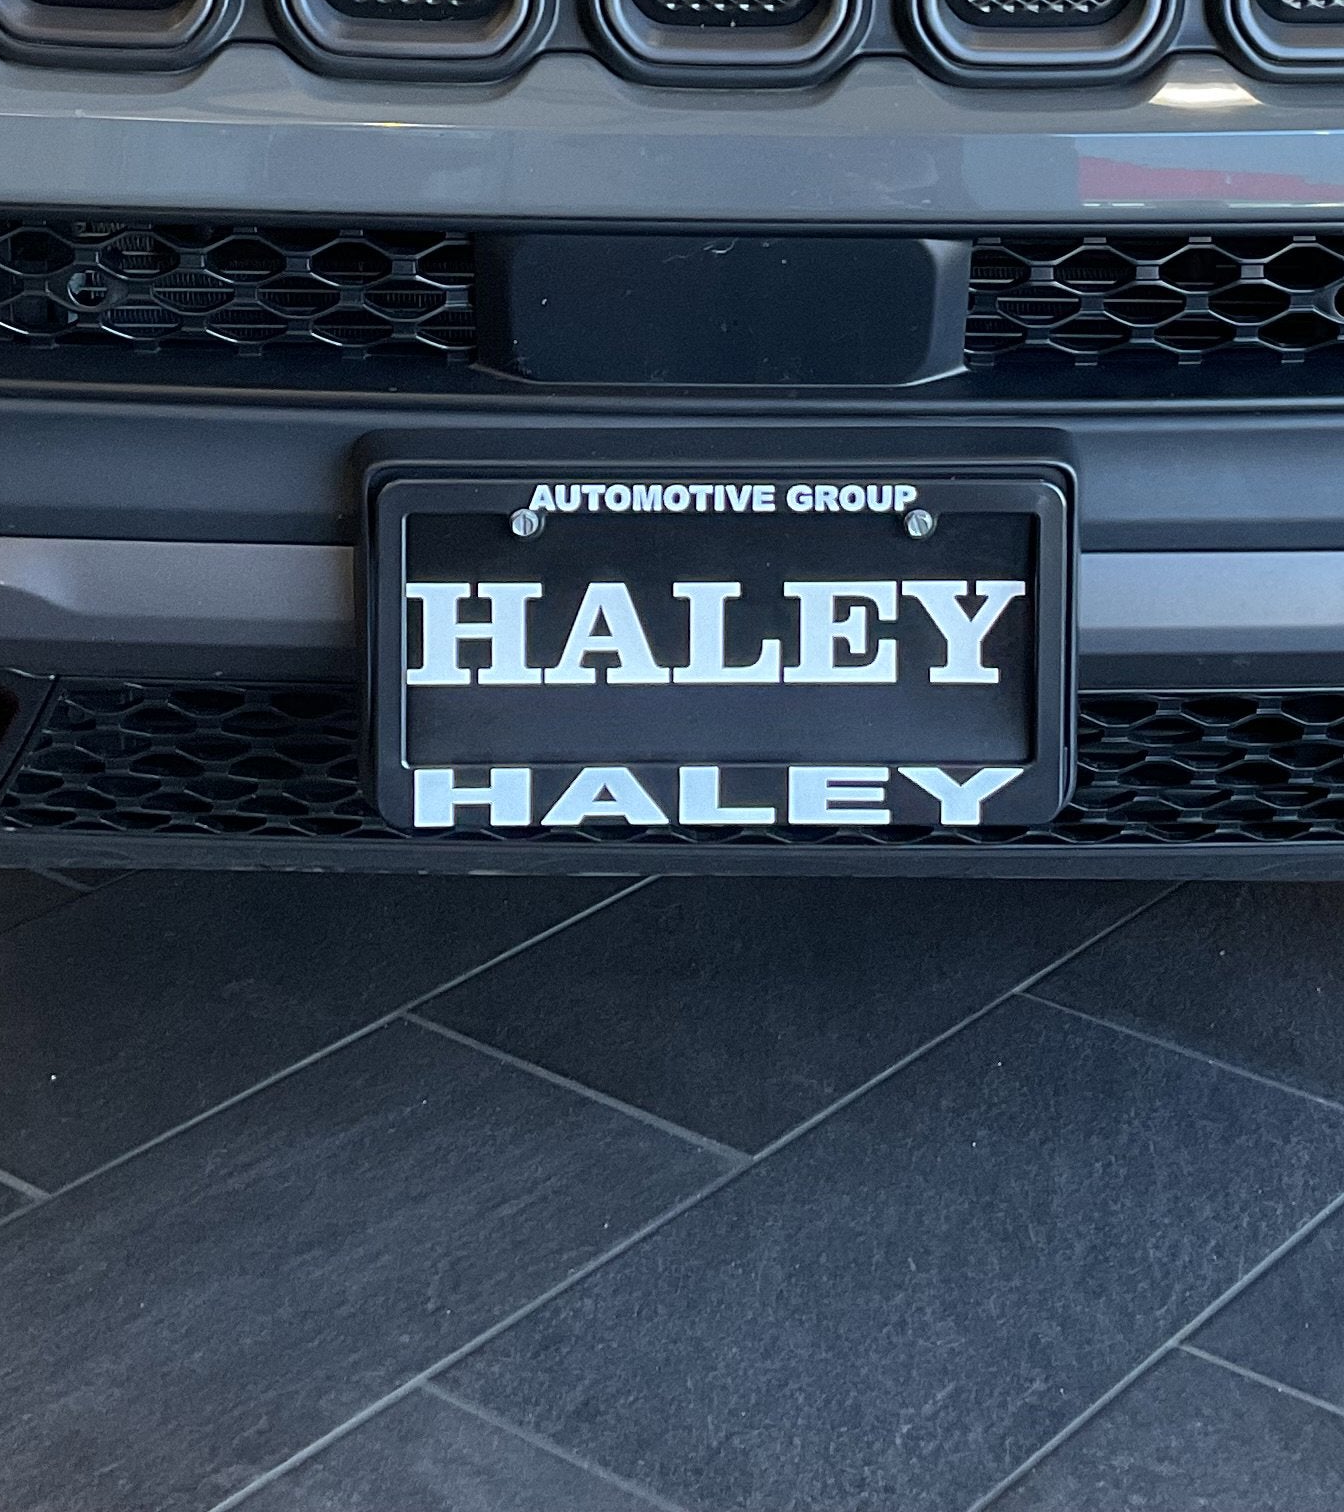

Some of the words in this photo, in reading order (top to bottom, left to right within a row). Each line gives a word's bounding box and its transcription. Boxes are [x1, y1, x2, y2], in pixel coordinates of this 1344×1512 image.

[528, 484, 776, 513] AUTOMOTIVE
[786, 484, 918, 513] GROUP
[406, 580, 1026, 685] HALEY
[413, 765, 1025, 828] HALEY
